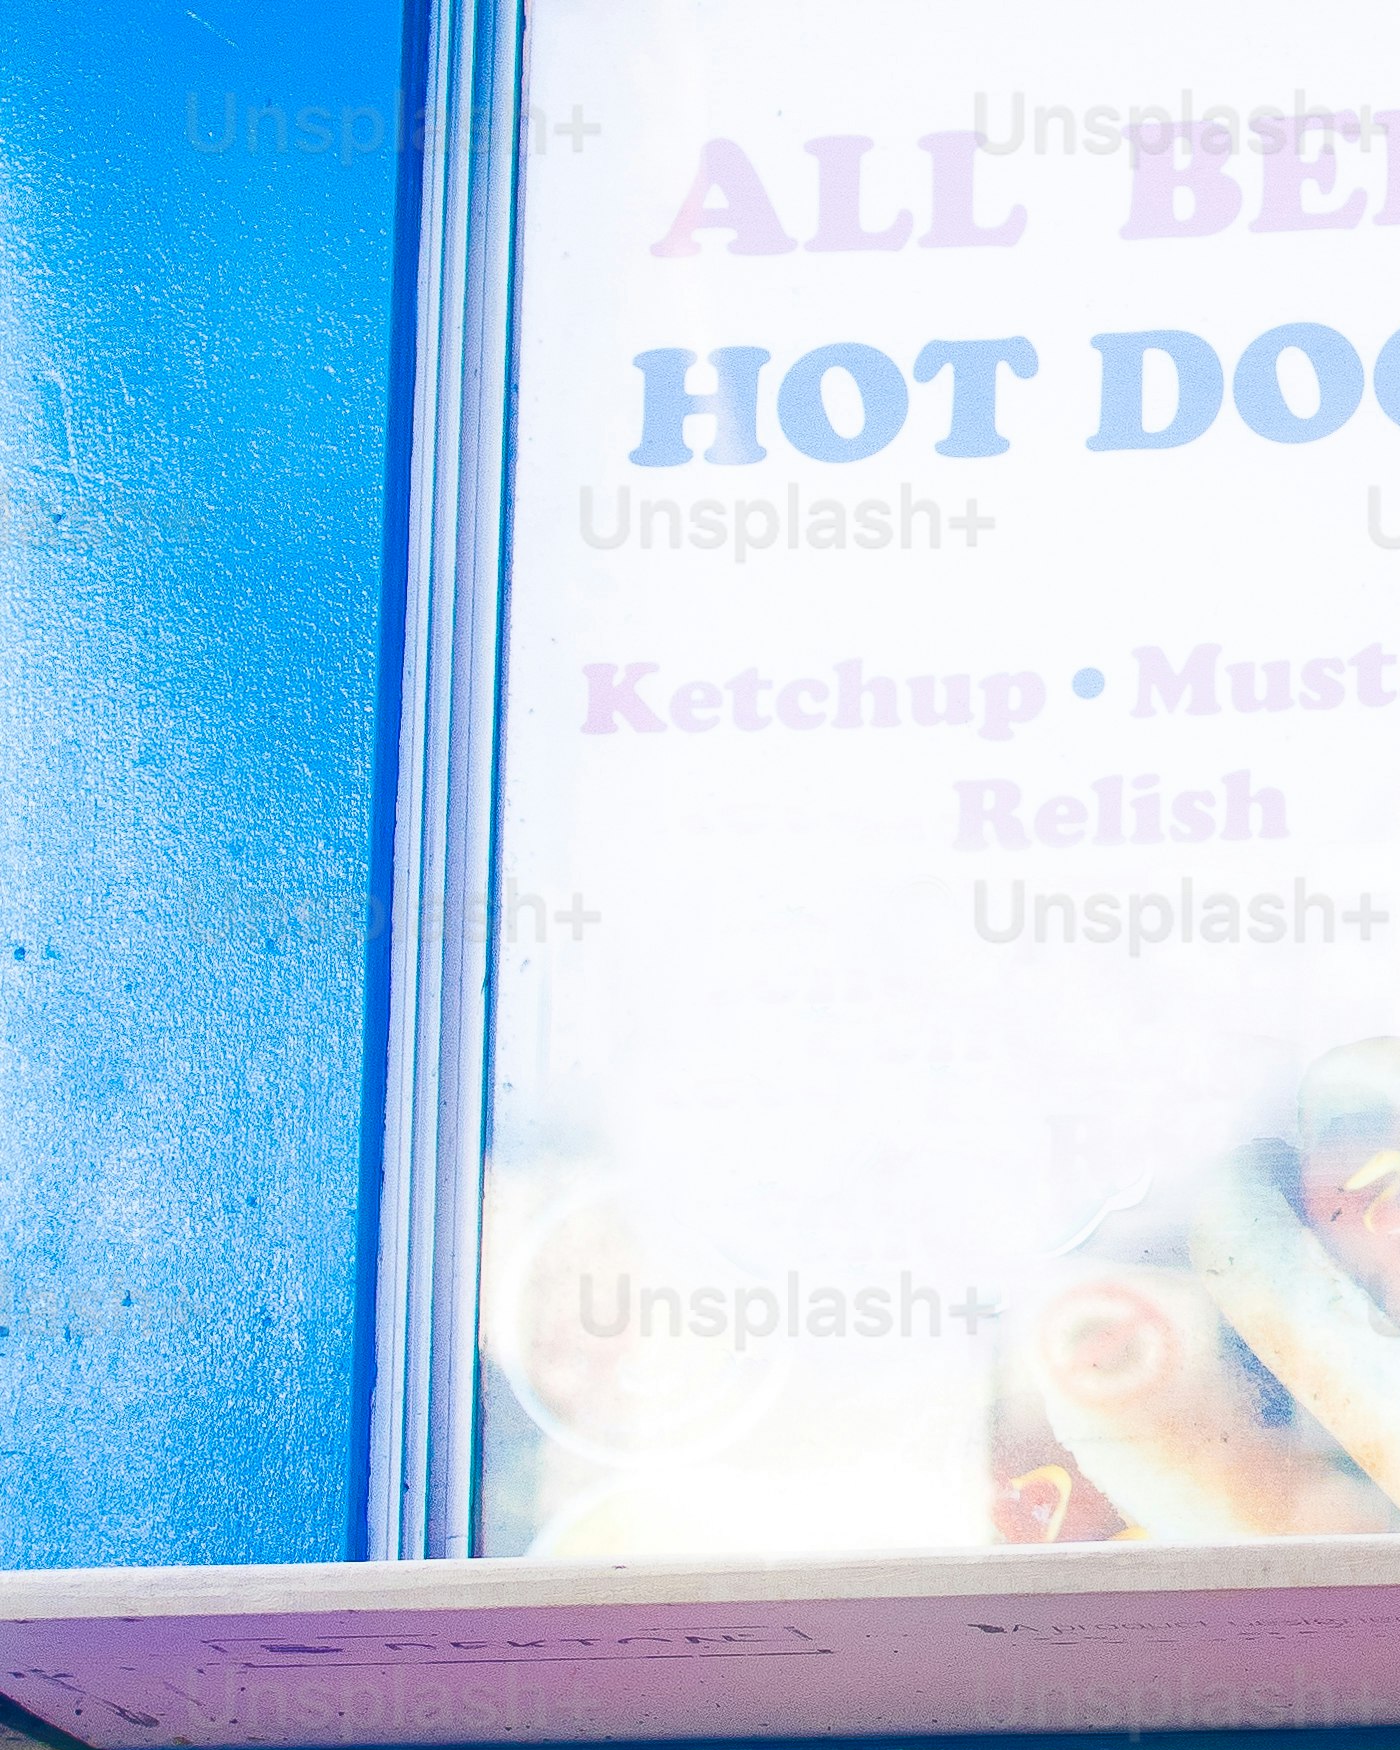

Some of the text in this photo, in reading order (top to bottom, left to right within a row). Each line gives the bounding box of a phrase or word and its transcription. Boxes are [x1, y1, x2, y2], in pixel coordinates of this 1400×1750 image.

[651, 131, 1027, 258] ALL
[626, 334, 1041, 470] HOT
[580, 658, 1046, 742] Ketchup
[951, 768, 1291, 852] Relish
